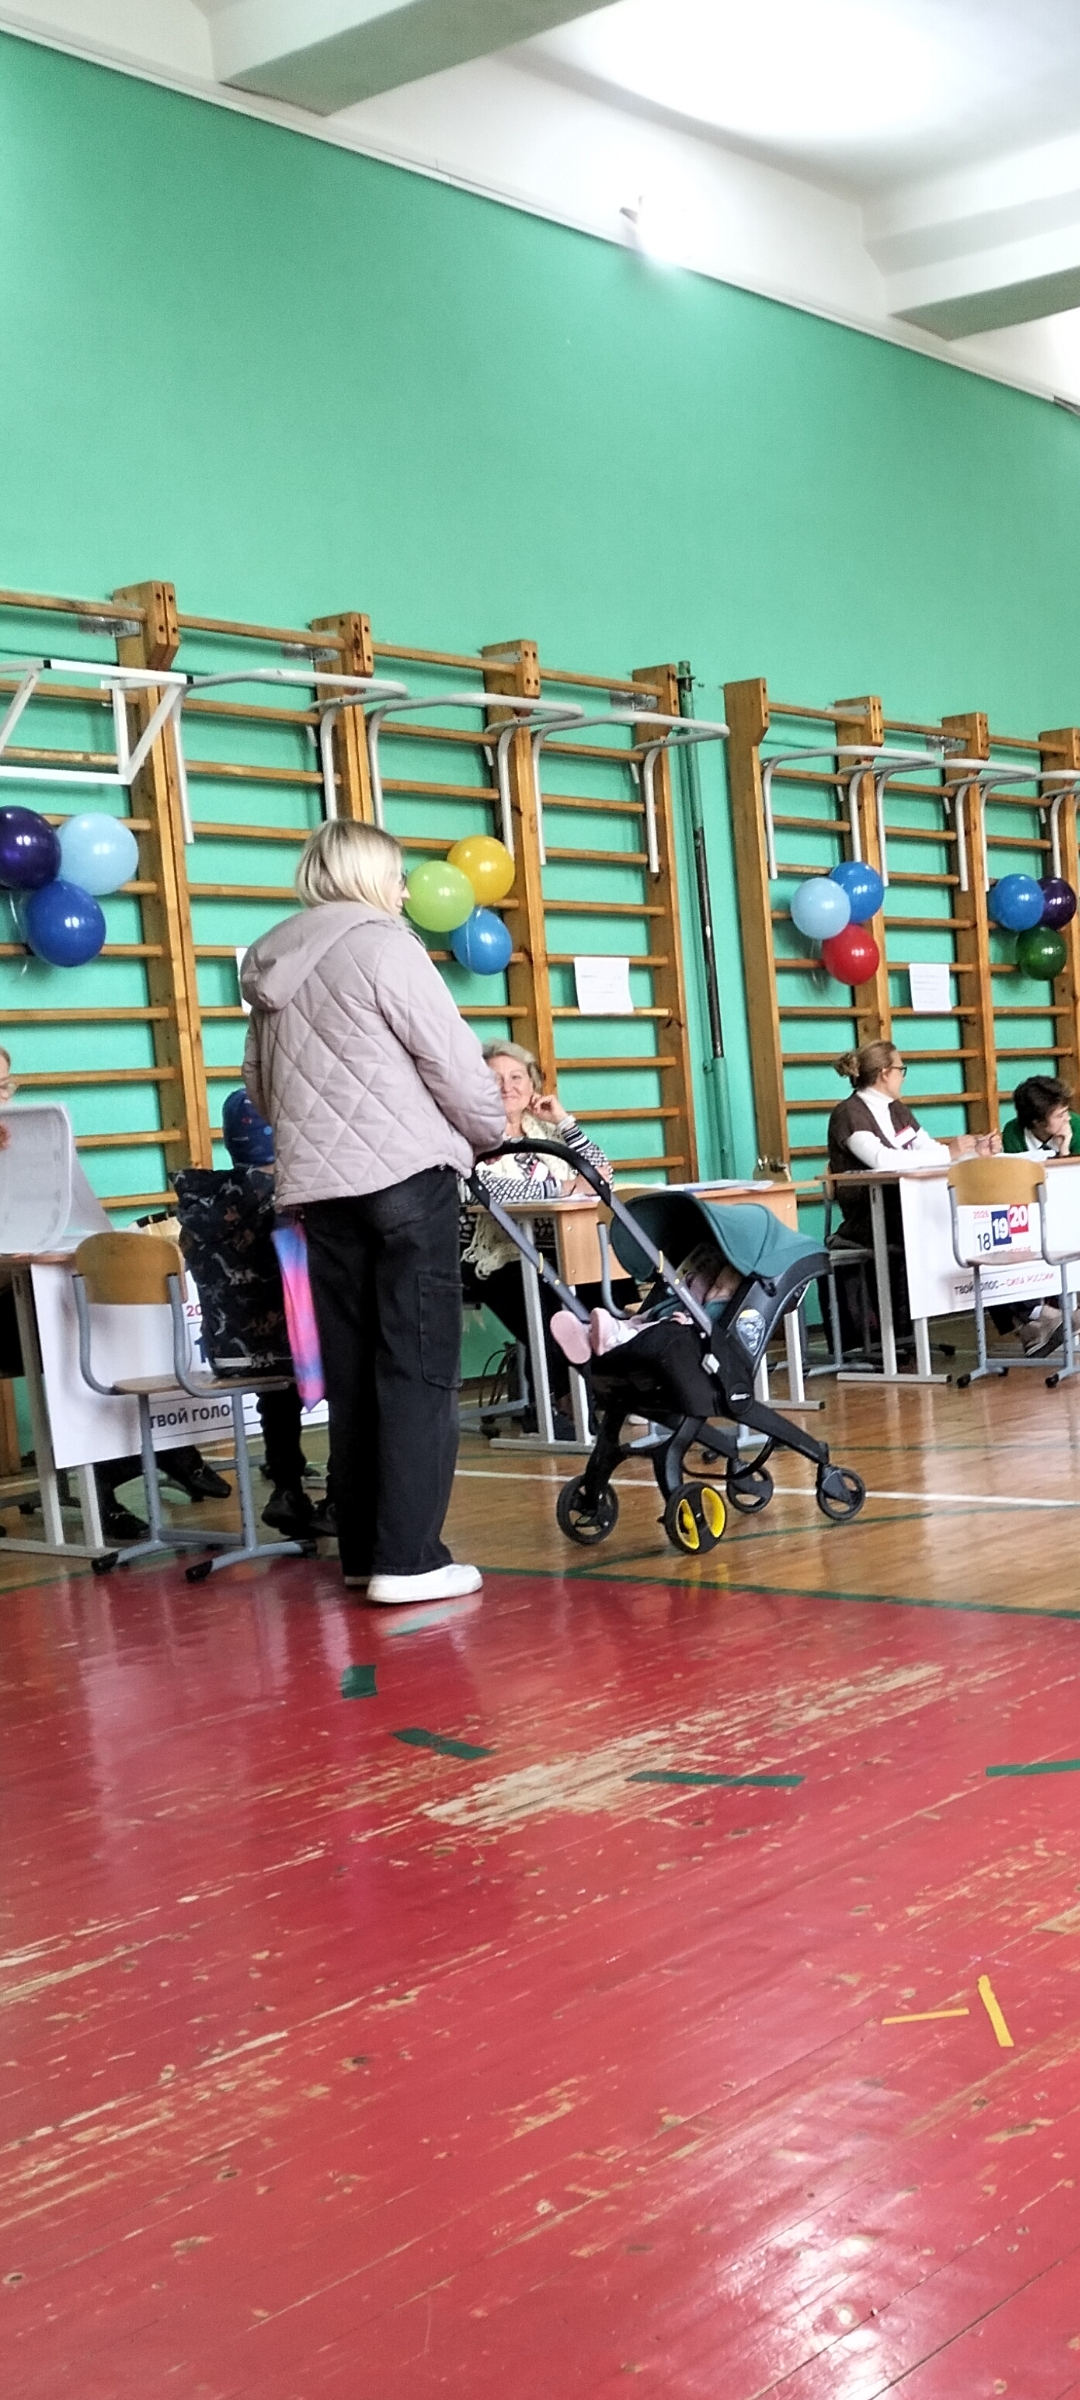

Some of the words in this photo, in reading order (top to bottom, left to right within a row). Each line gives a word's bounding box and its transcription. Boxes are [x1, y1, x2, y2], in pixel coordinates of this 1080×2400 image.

[977, 1232, 991, 1251] 18
[992, 1217, 1009, 1240] 19
[1009, 1204, 1028, 1228] 20
[979, 1280, 999, 1293] ОЛОС
[186, 1304, 202, 1317] 20
[150, 1407, 188, 1429] ТВОЙ
[192, 1404, 231, 1422] ГОЛО
